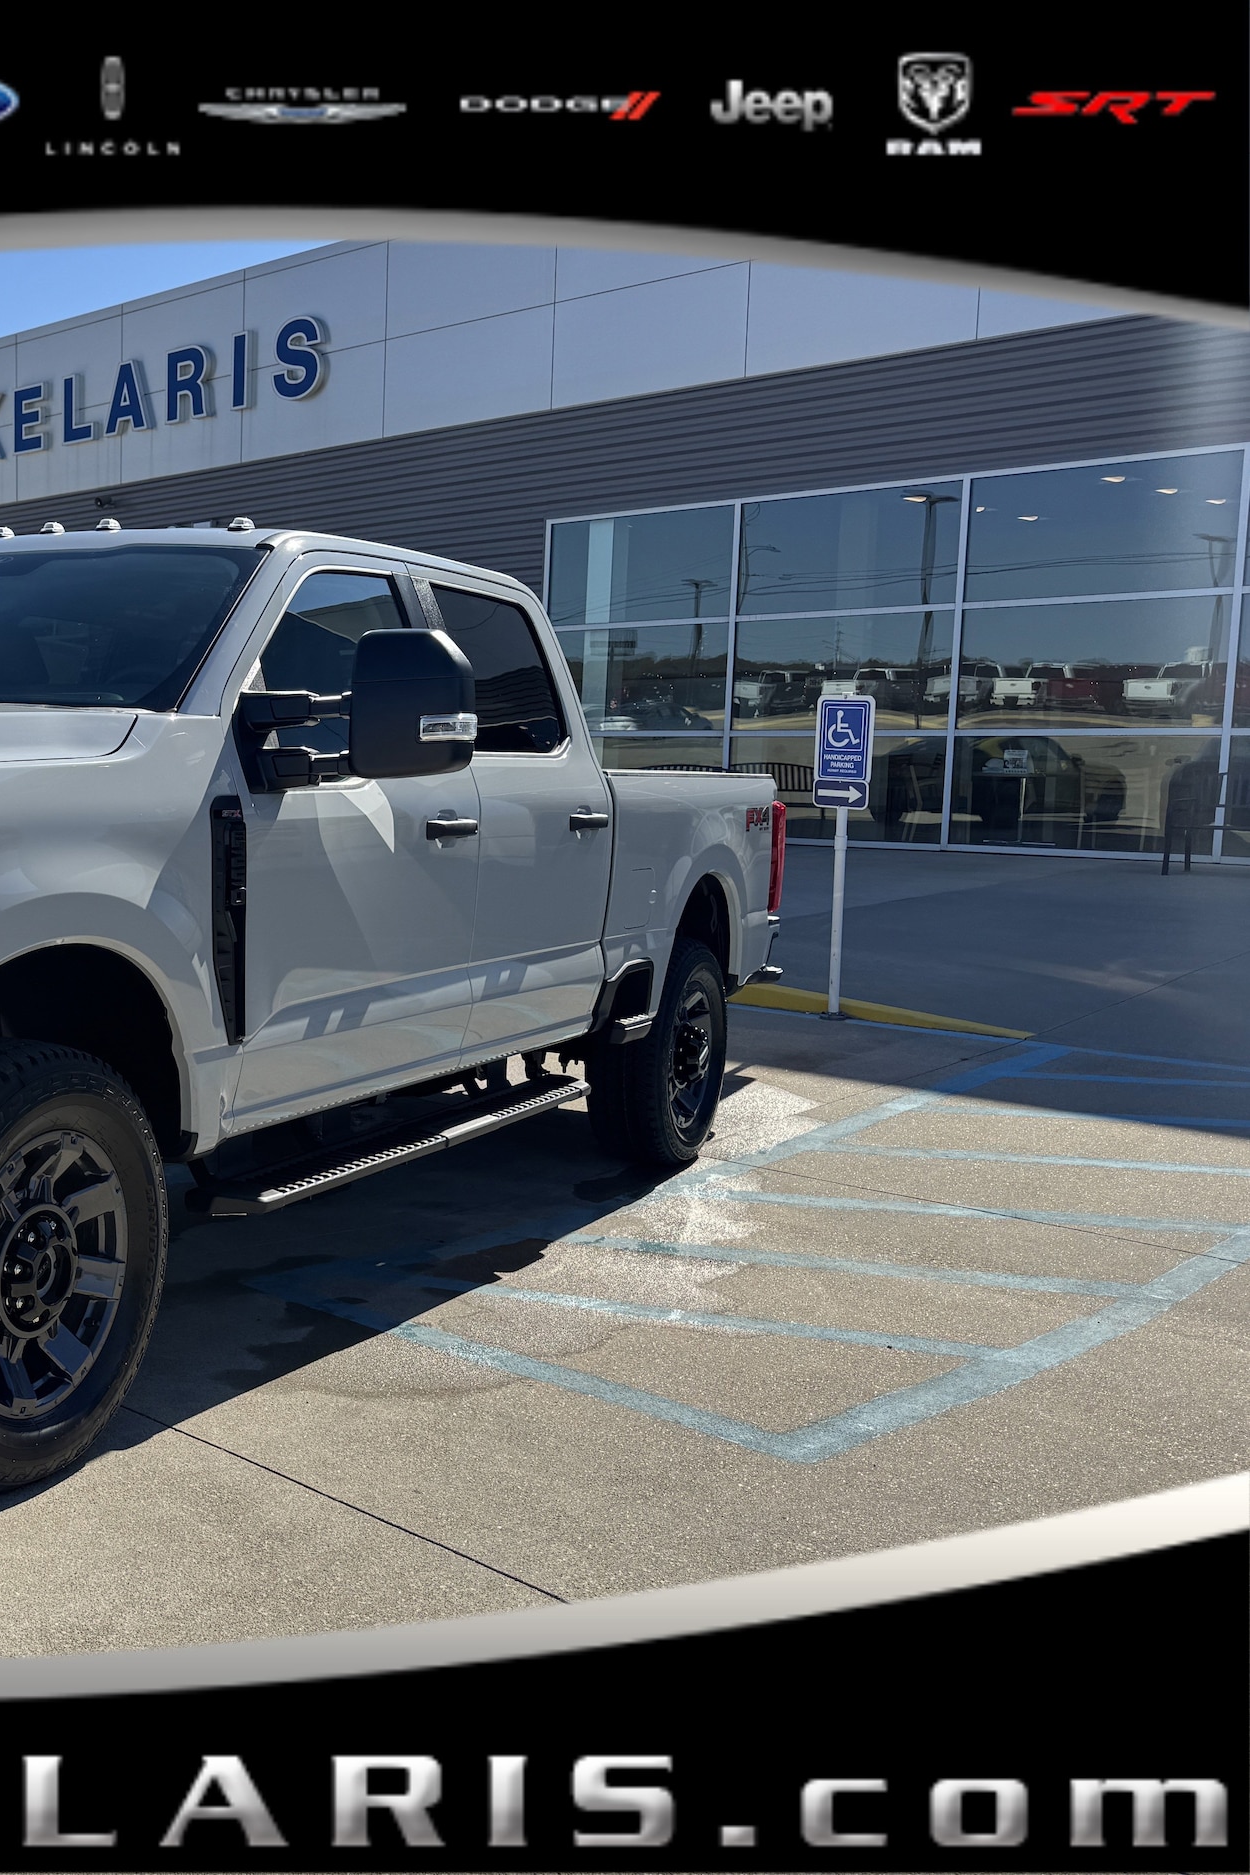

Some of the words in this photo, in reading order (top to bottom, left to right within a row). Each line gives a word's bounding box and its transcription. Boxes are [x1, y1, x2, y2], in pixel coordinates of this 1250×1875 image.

[823, 753, 862, 762] HANDICAPPED
[830, 761, 854, 769] PARKING
[746, 807, 770, 831] FX4
